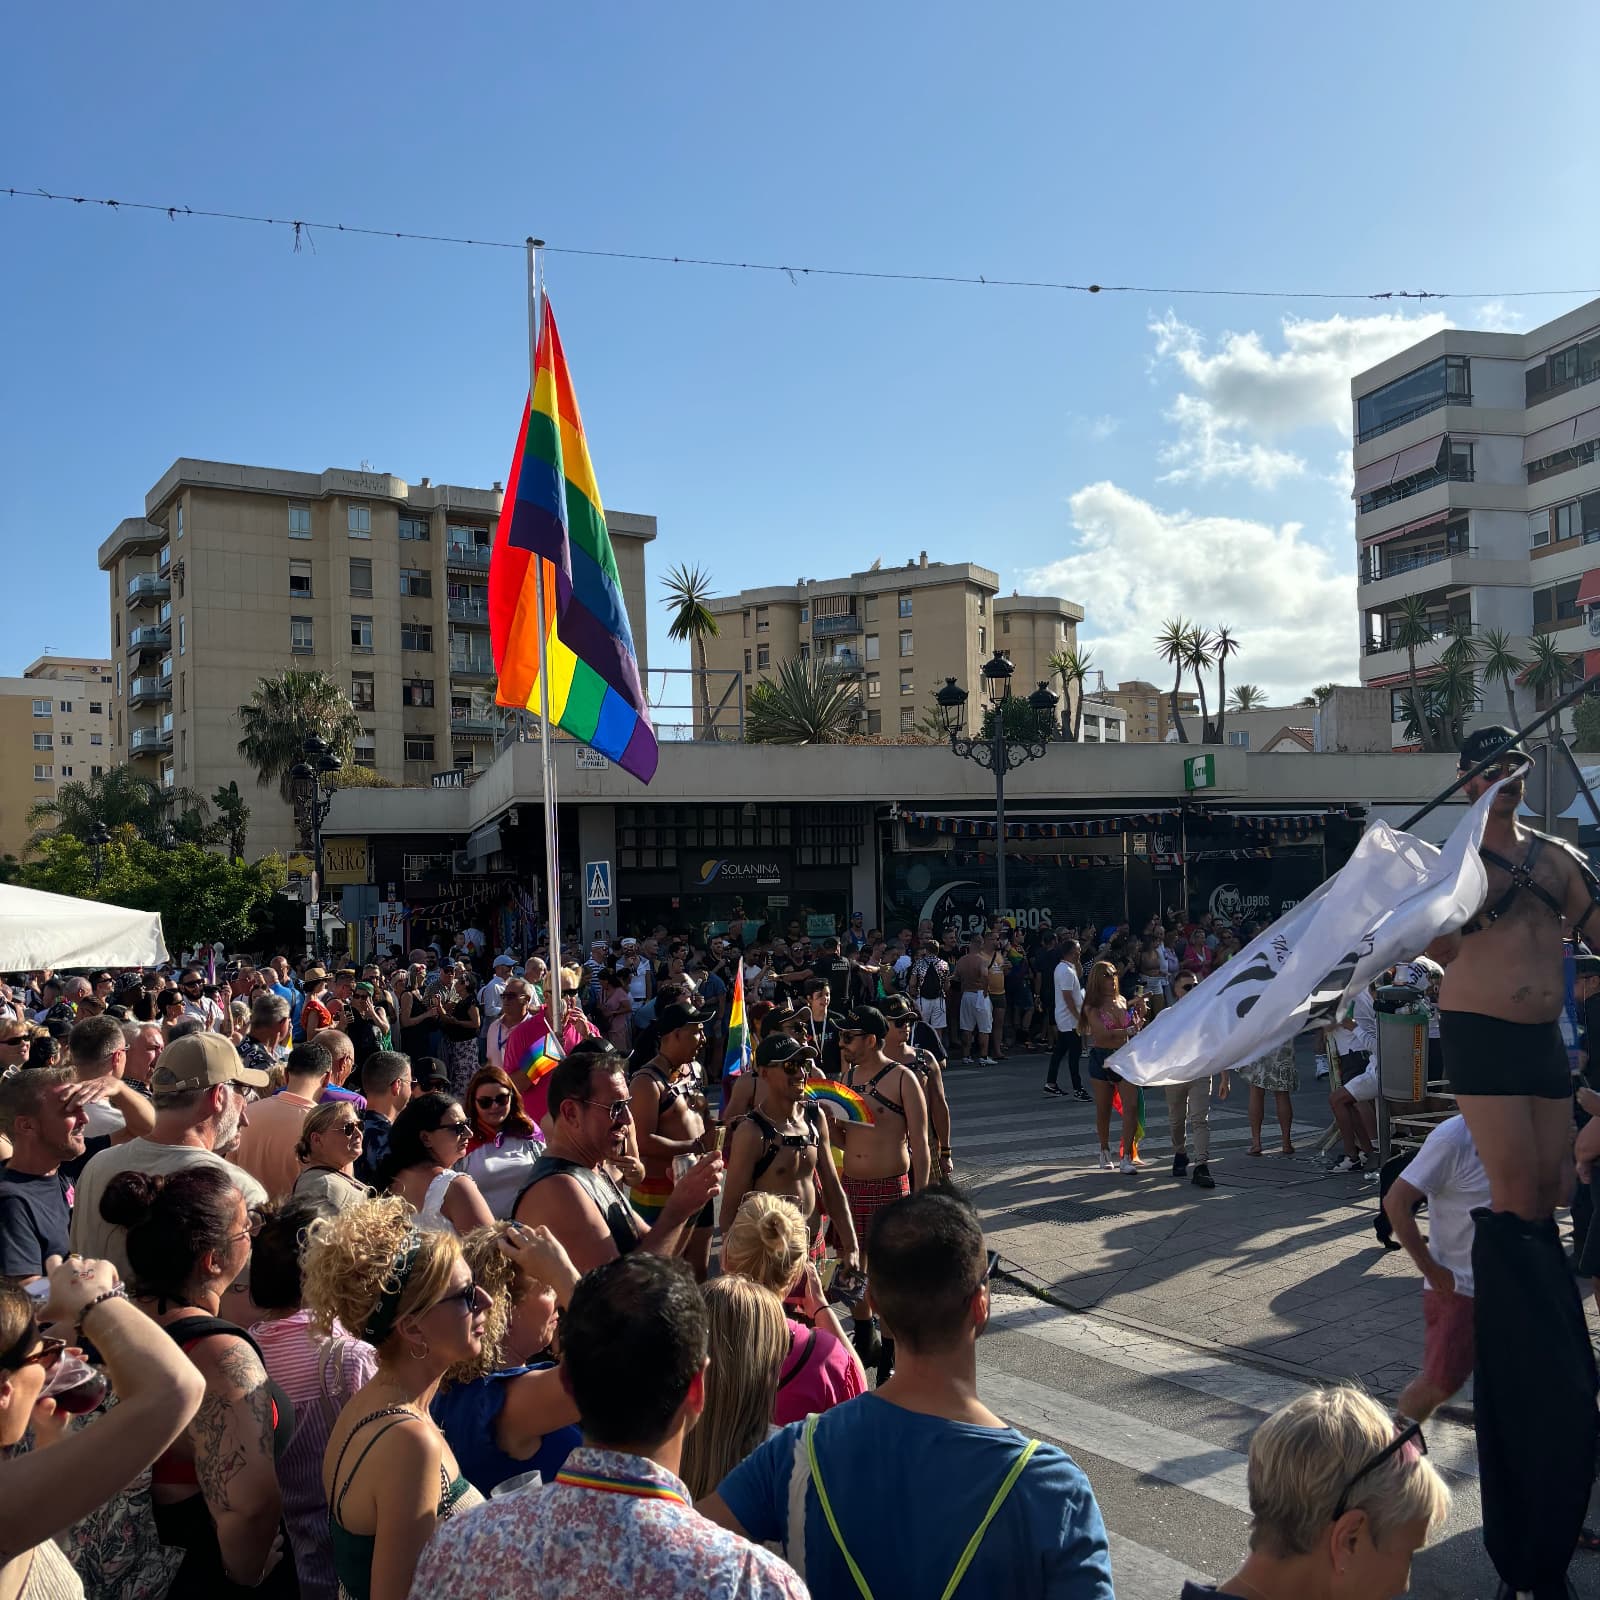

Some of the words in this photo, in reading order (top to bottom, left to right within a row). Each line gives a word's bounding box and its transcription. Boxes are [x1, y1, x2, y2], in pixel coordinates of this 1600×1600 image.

[329, 856, 366, 871] KIKO
[721, 863, 780, 875] SOLANINA
[438, 882, 463, 896] BAR
[1241, 895, 1270, 907] LOBOS
